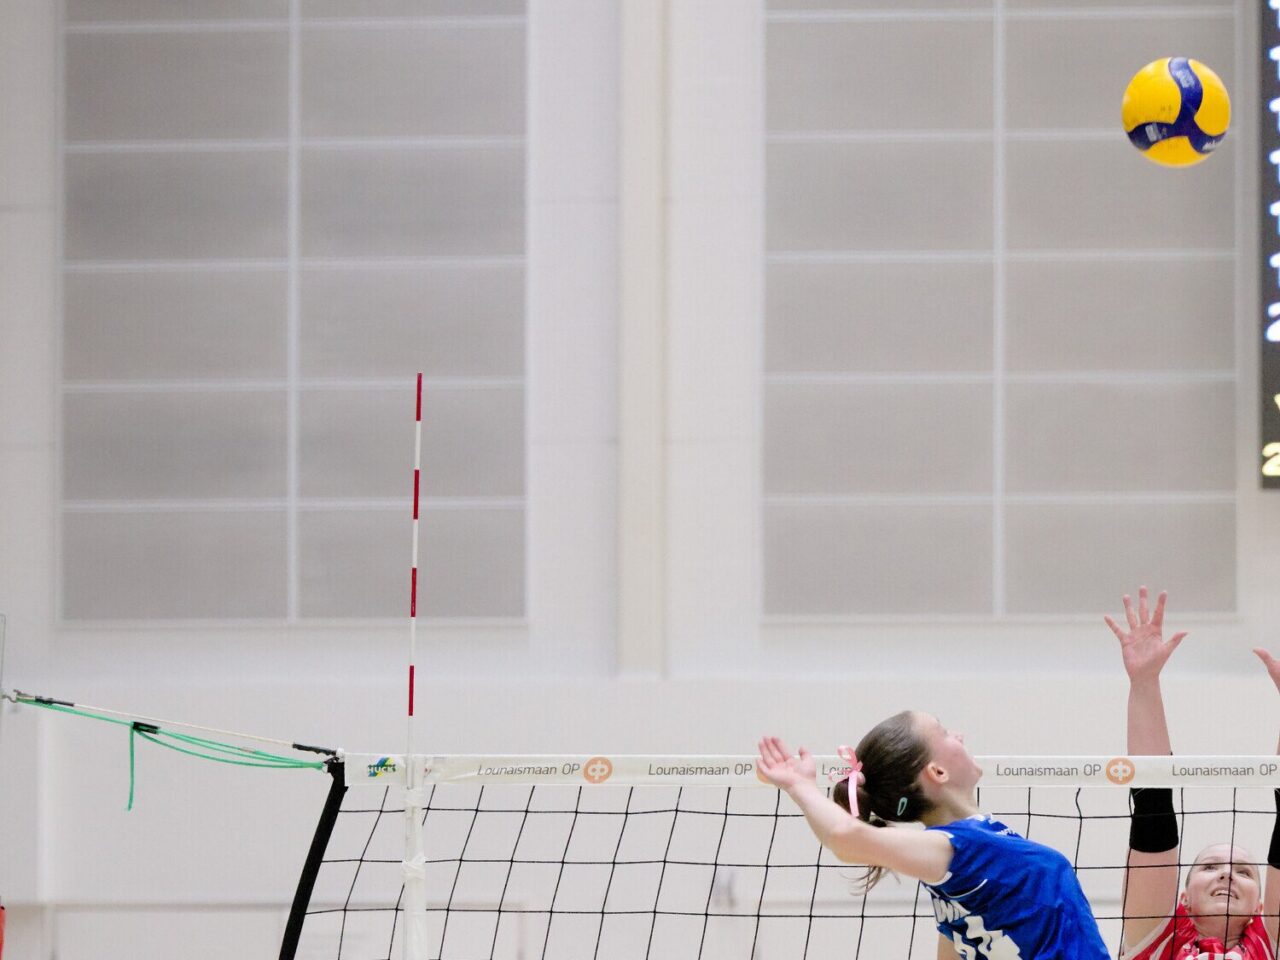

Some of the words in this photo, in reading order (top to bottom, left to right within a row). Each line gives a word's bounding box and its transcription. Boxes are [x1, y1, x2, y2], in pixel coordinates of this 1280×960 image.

[477, 764, 558, 776] Lounaismaan
[561, 762, 581, 776] OP
[648, 763, 730, 776] Lounaismaan
[734, 762, 753, 776] OP
[996, 763, 1079, 777] Lounaismaan
[1083, 763, 1102, 777] OP
[1171, 764, 1255, 777] Lounaismaan
[1259, 763, 1278, 777] OP
